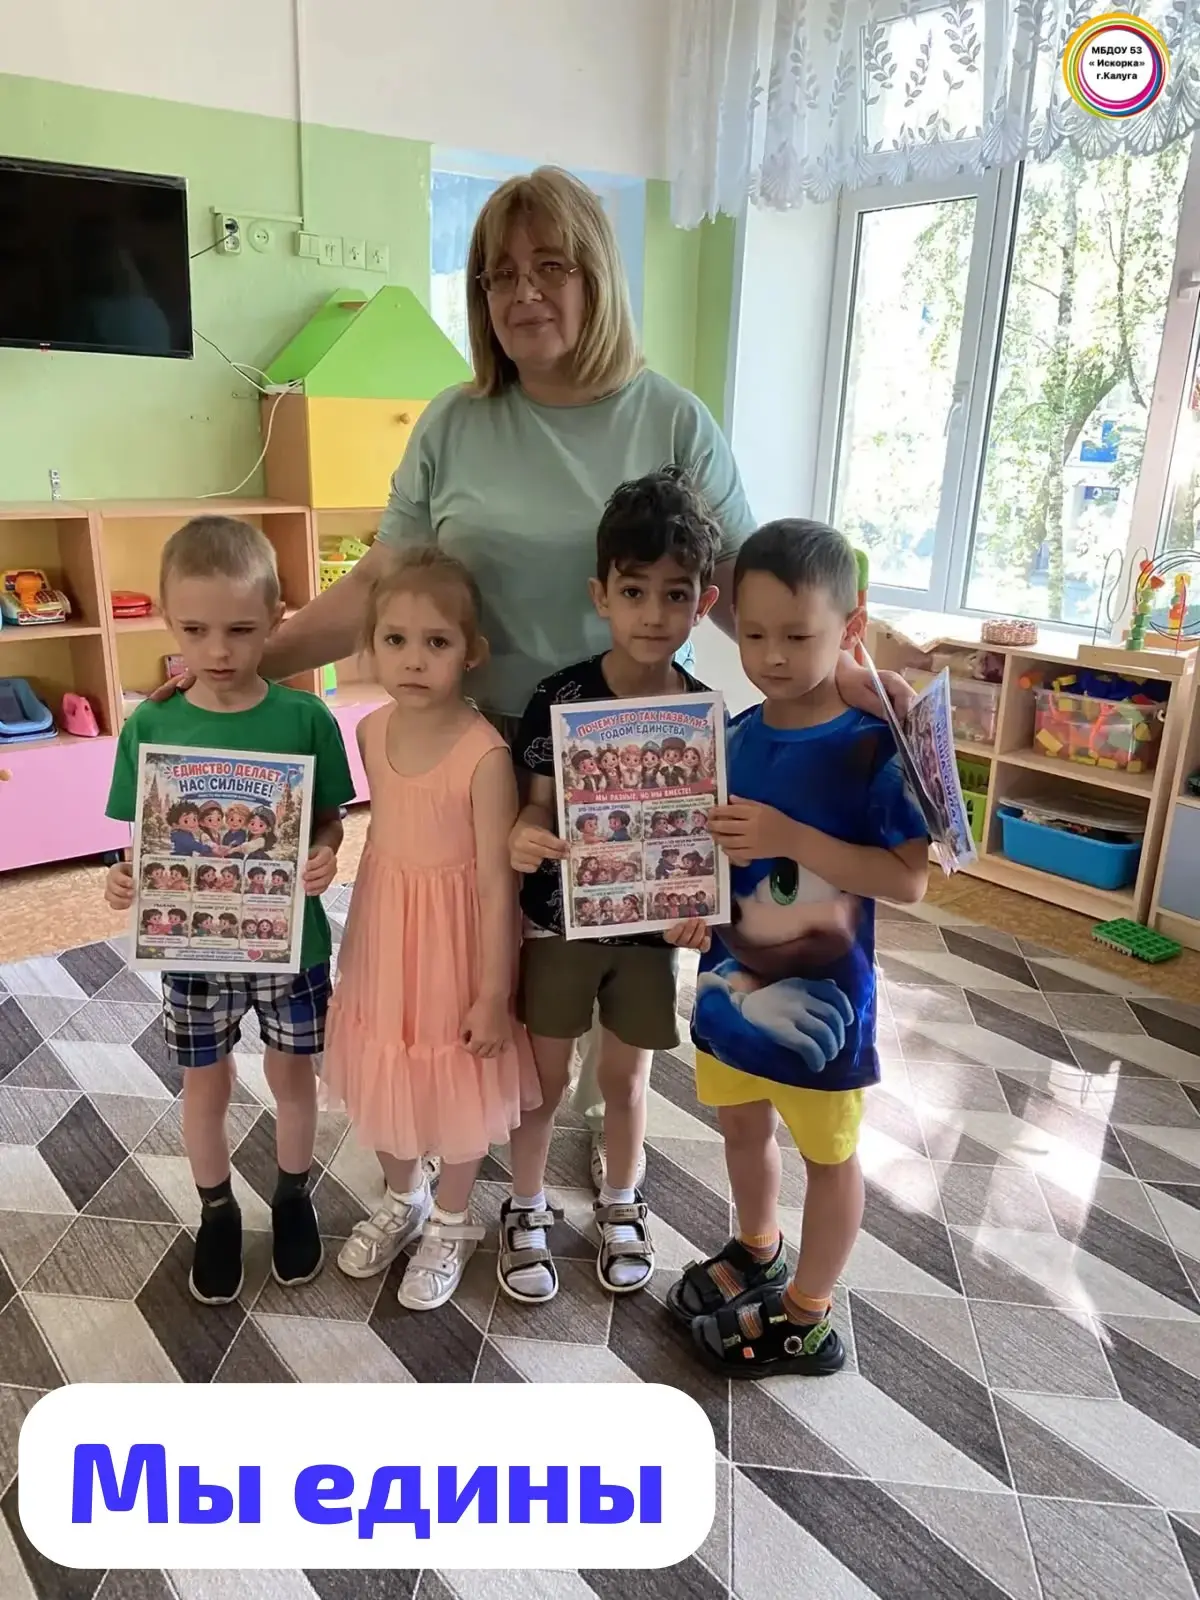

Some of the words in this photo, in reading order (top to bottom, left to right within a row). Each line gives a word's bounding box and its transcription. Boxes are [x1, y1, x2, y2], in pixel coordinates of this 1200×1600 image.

[619, 713, 636, 723] ЕГО
[639, 712, 657, 722] ТАК
[659, 712, 708, 729] НАЗВАЛИ?
[600, 726, 633, 741] ГОДОМ
[636, 724, 686, 737] ЕДИНСТВА
[173, 763, 233, 778] ЕДИНСТВО
[235, 764, 282, 782] ДЕЛАЕТ
[179, 778, 205, 793] НАС
[209, 779, 274, 798] СИЛЬНЕЕ!
[665, 787, 692, 798] ВМЕСТЕ!
